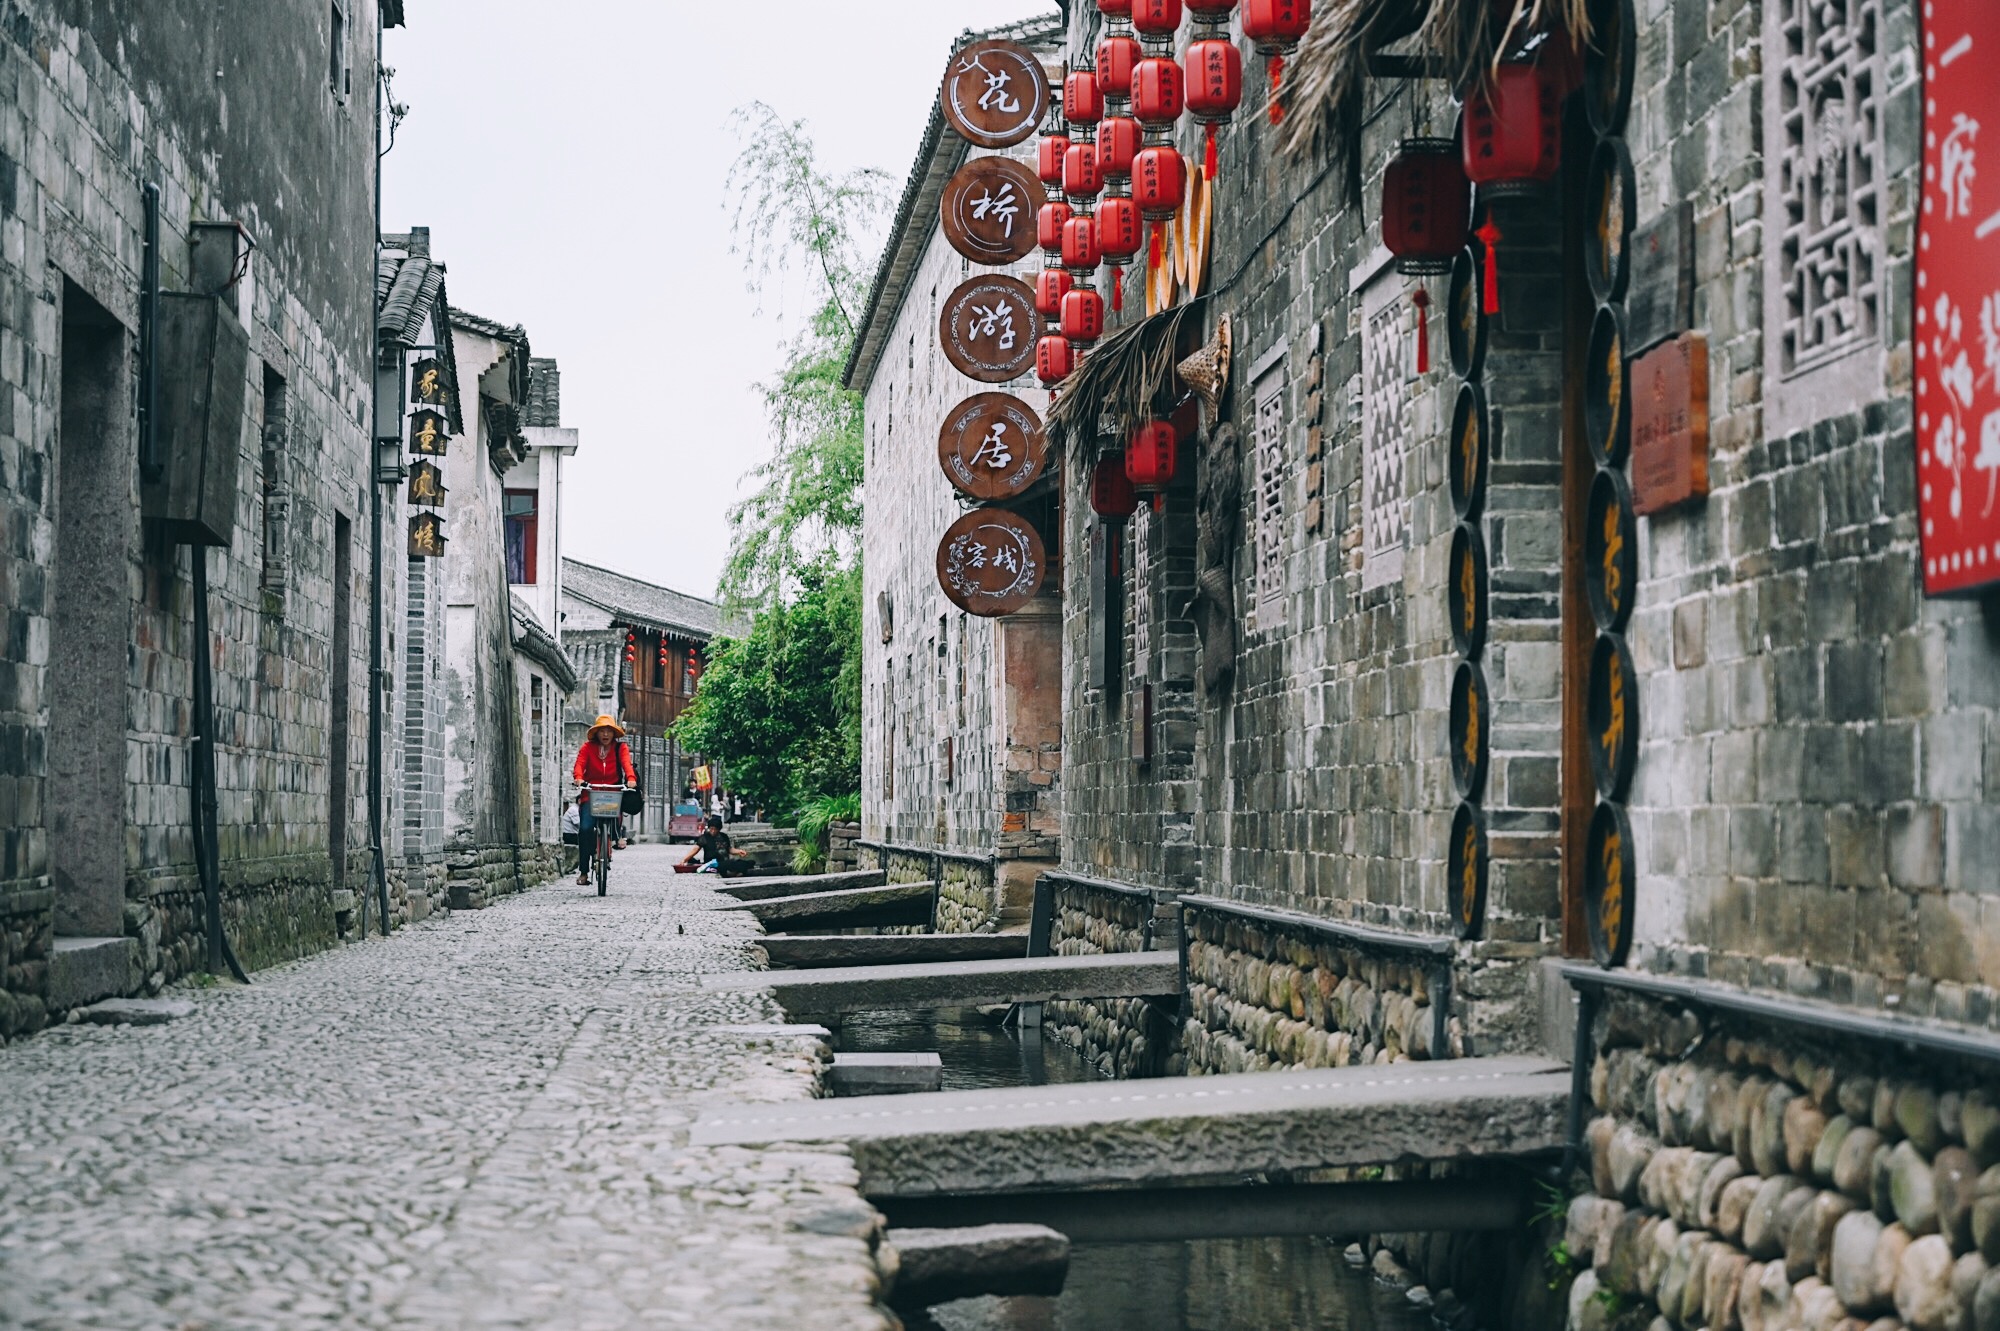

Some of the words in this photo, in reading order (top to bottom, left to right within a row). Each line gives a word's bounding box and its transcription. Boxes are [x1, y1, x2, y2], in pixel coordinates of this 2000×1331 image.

[1208, 50, 1223, 97] 花桥游居
[1103, 126, 1112, 162] 花桥游居
[1144, 156, 1157, 199] 花桥游居
